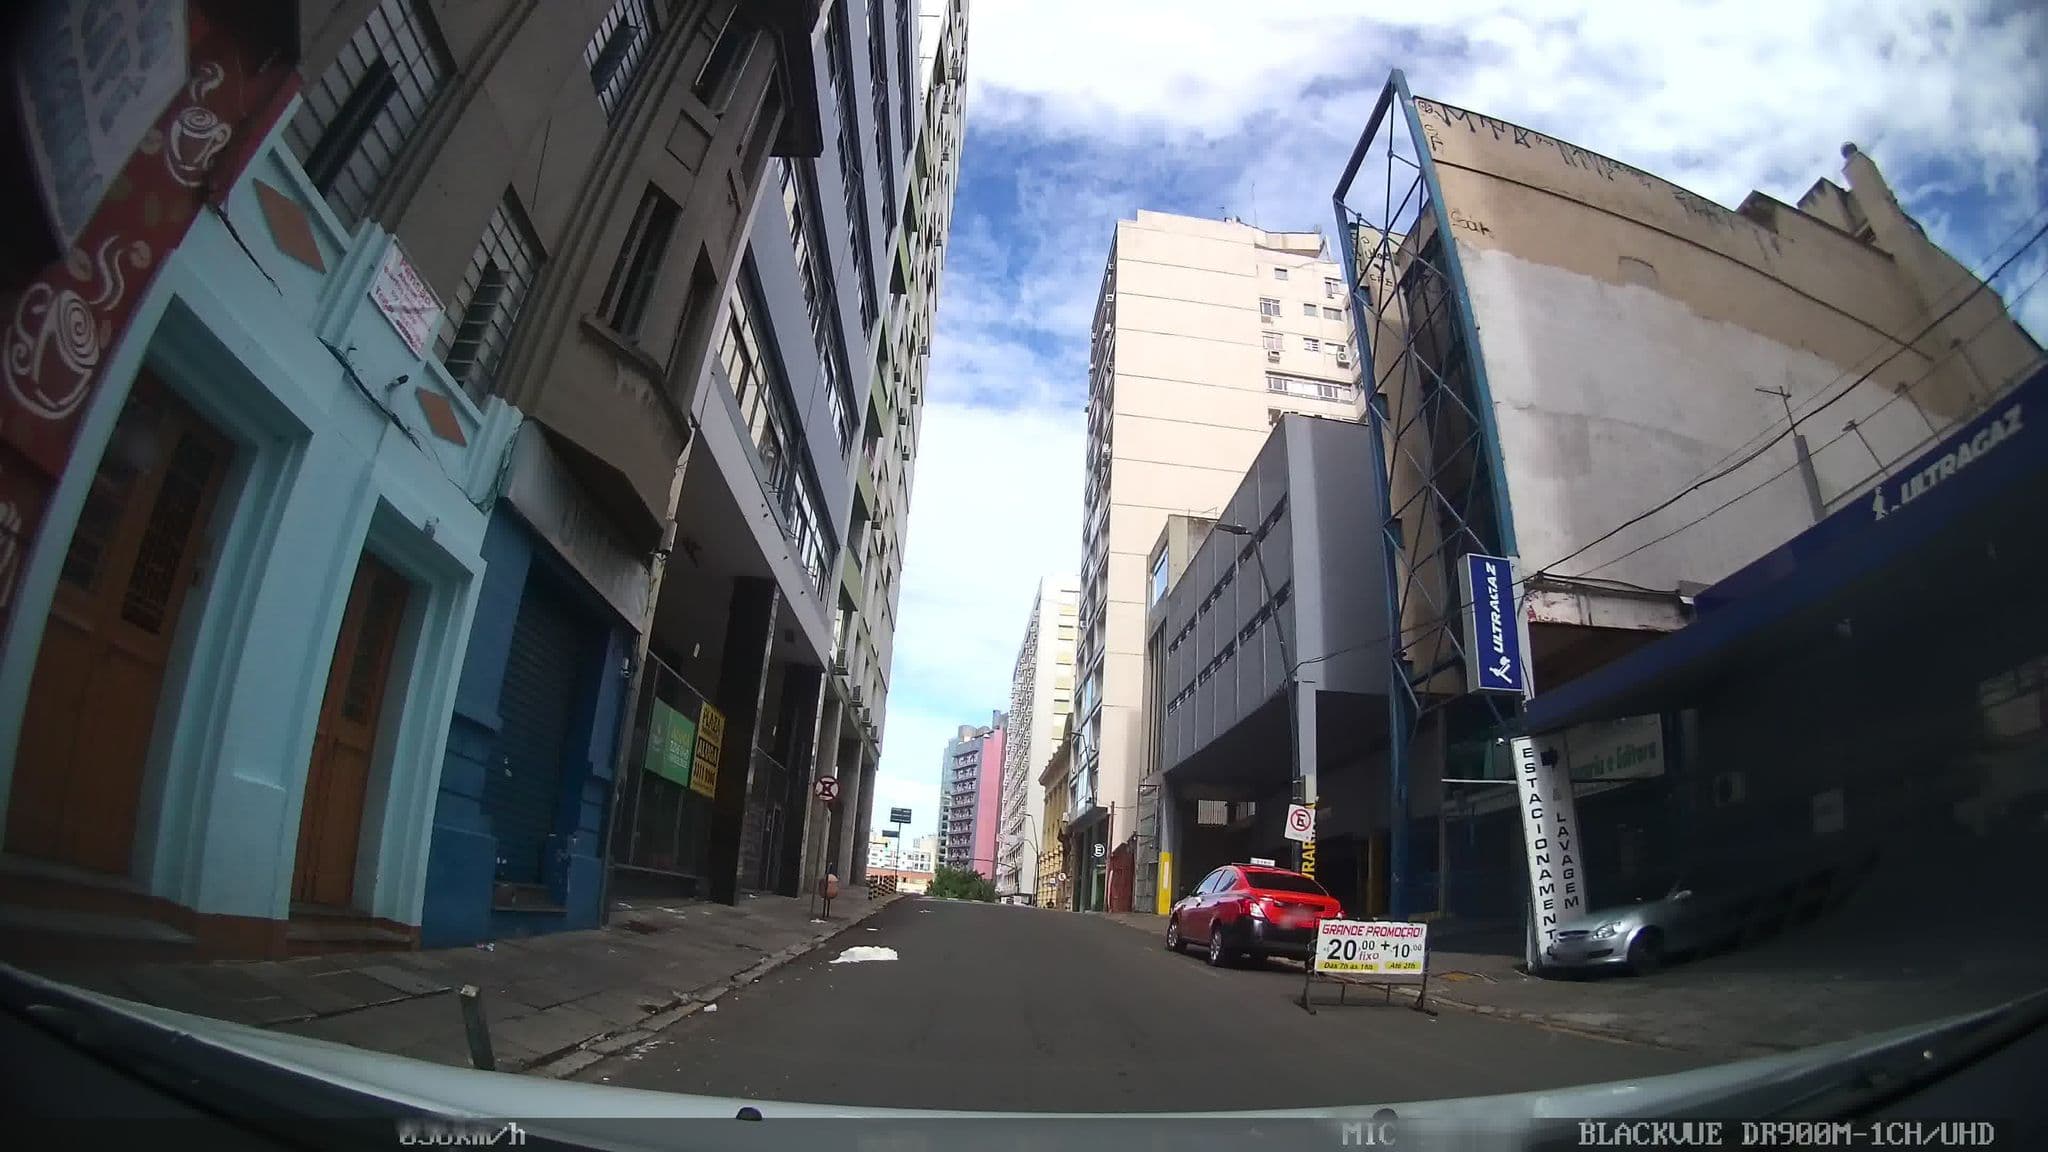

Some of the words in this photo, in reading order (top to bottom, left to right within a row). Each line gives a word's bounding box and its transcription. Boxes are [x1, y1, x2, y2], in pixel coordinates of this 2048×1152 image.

[1901, 403, 2024, 504] ULTRAGAZ
[1486, 561, 1504, 654] ULTRAGAZ
[1556, 812, 1580, 909] LAVAGEM
[1322, 924, 1364, 936] GRANDE
